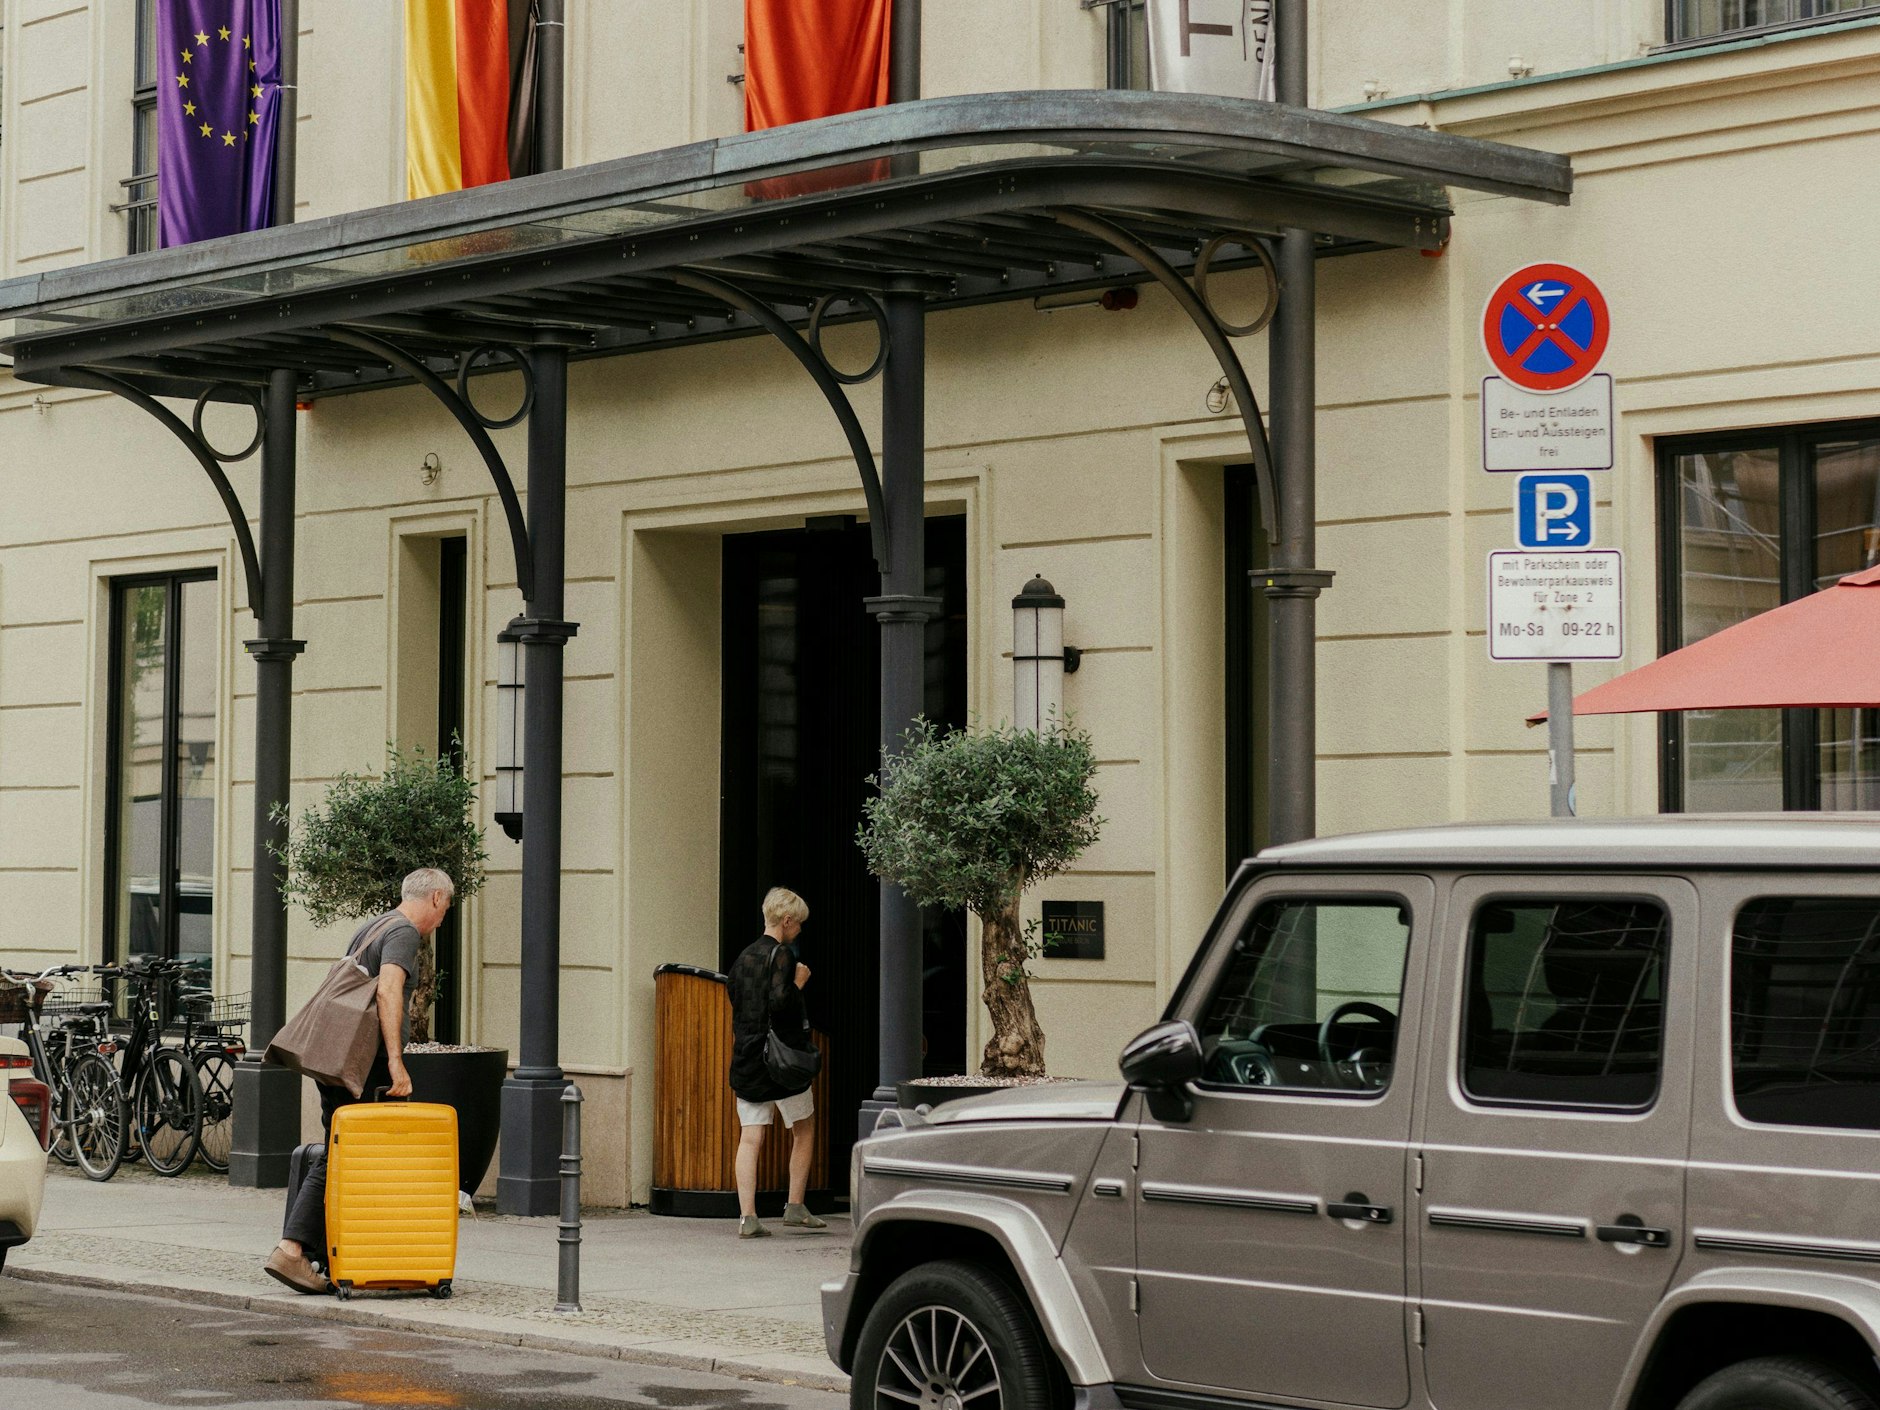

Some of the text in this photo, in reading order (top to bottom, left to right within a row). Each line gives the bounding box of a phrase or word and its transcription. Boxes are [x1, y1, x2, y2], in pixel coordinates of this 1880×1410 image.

[1500, 406, 1599, 419] Be- und Entladen
[1491, 426, 1605, 439] Ein- und Aussteigen
[1539, 446, 1559, 456] frei
[1535, 482, 1579, 541] P
[1502, 558, 1608, 570] mit Parkschein oder
[1498, 575, 1613, 589] Bewohnerparkausweis
[1533, 591, 1594, 603] für Zone 2
[1500, 622, 1615, 636] Mo-Sa 09-22 h
[1048, 917, 1097, 932] TITANIC
